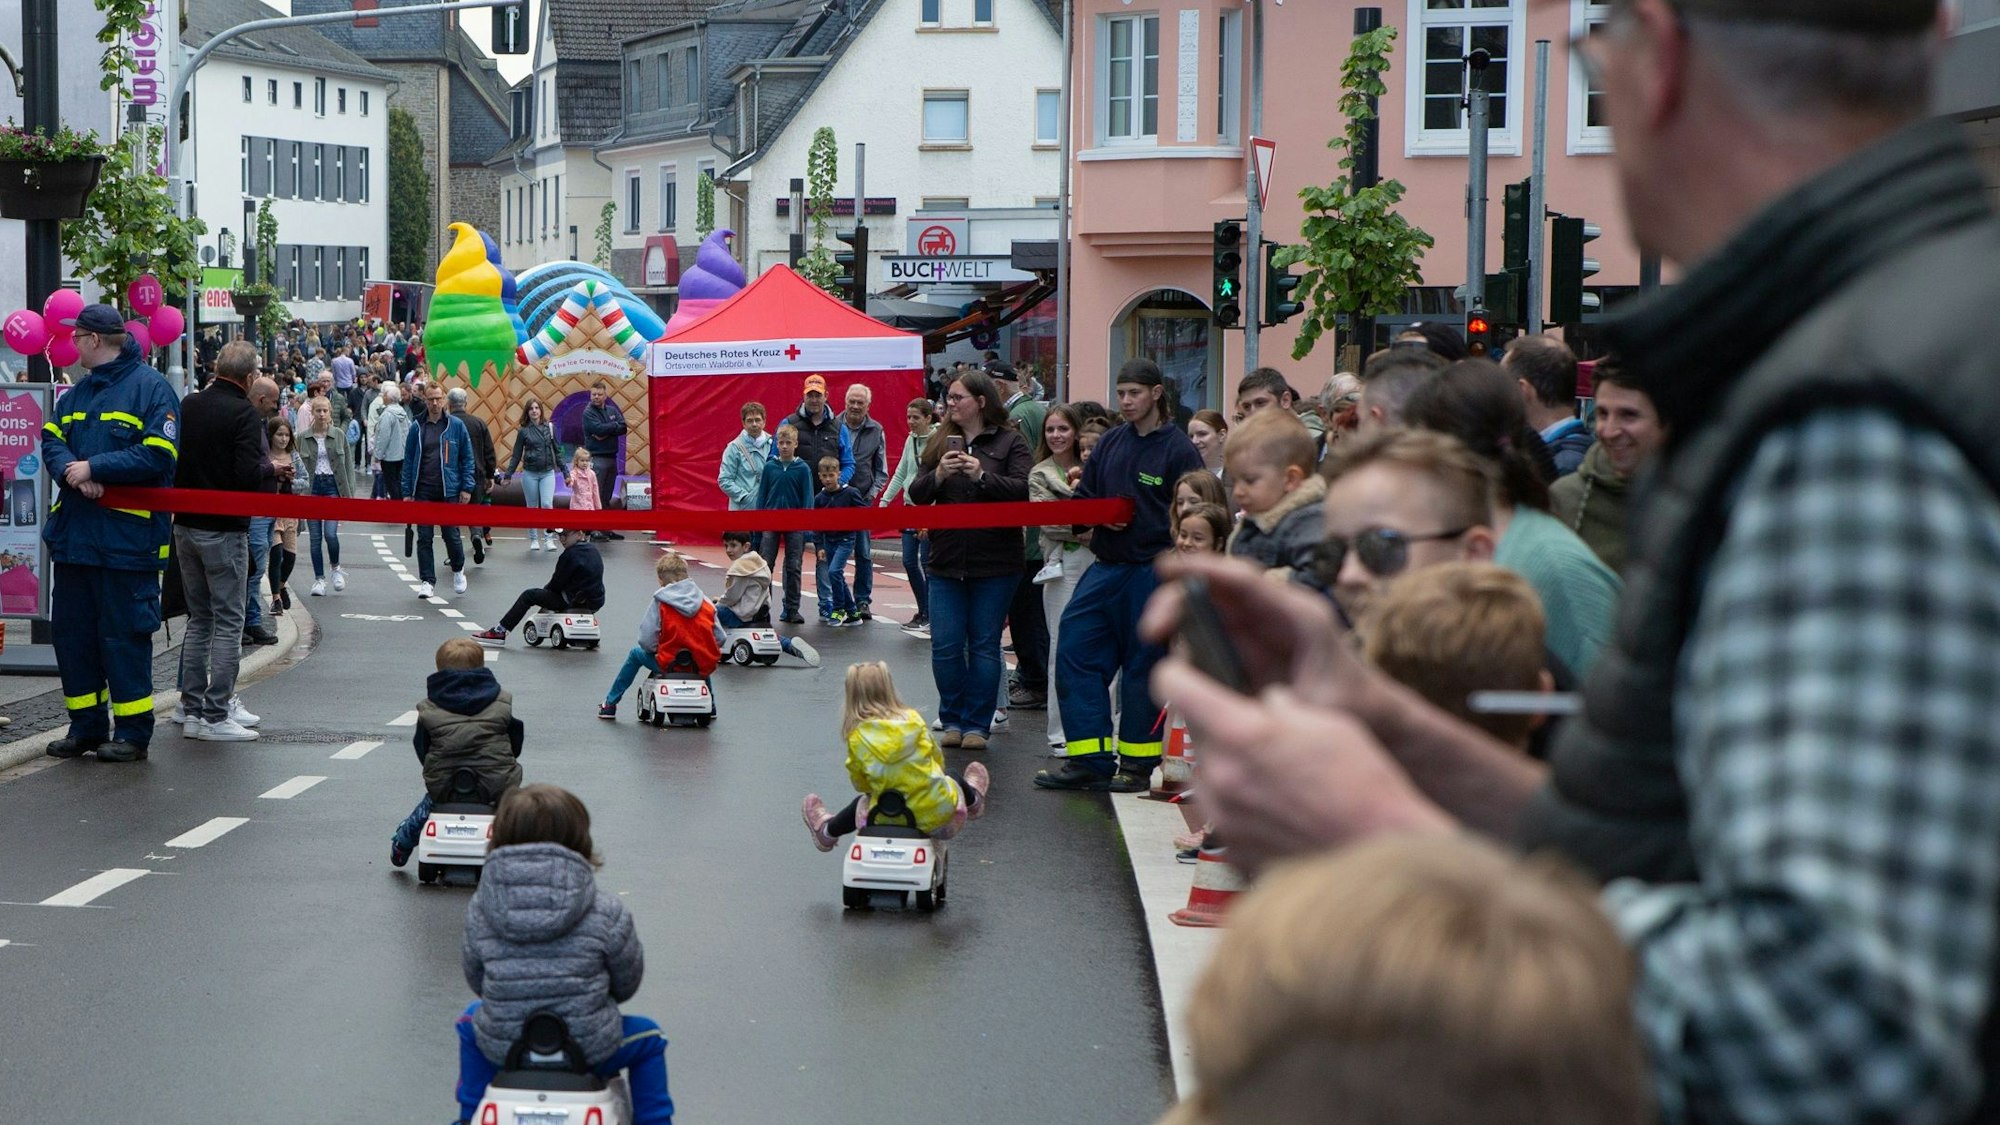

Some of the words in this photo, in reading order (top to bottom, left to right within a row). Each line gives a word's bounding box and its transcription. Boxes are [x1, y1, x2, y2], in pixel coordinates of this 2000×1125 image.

[138, 285, 155, 305] T
[6, 315, 30, 339] T
[665, 351, 718, 360] Deutsches
[720, 349, 750, 358] Rotes
[752, 348, 781, 356] Kreuz
[553, 362, 567, 370] The
[602, 359, 626, 371] Palace
[665, 361, 707, 370] Ortsverein
[708, 359, 745, 369] Waldbröl
